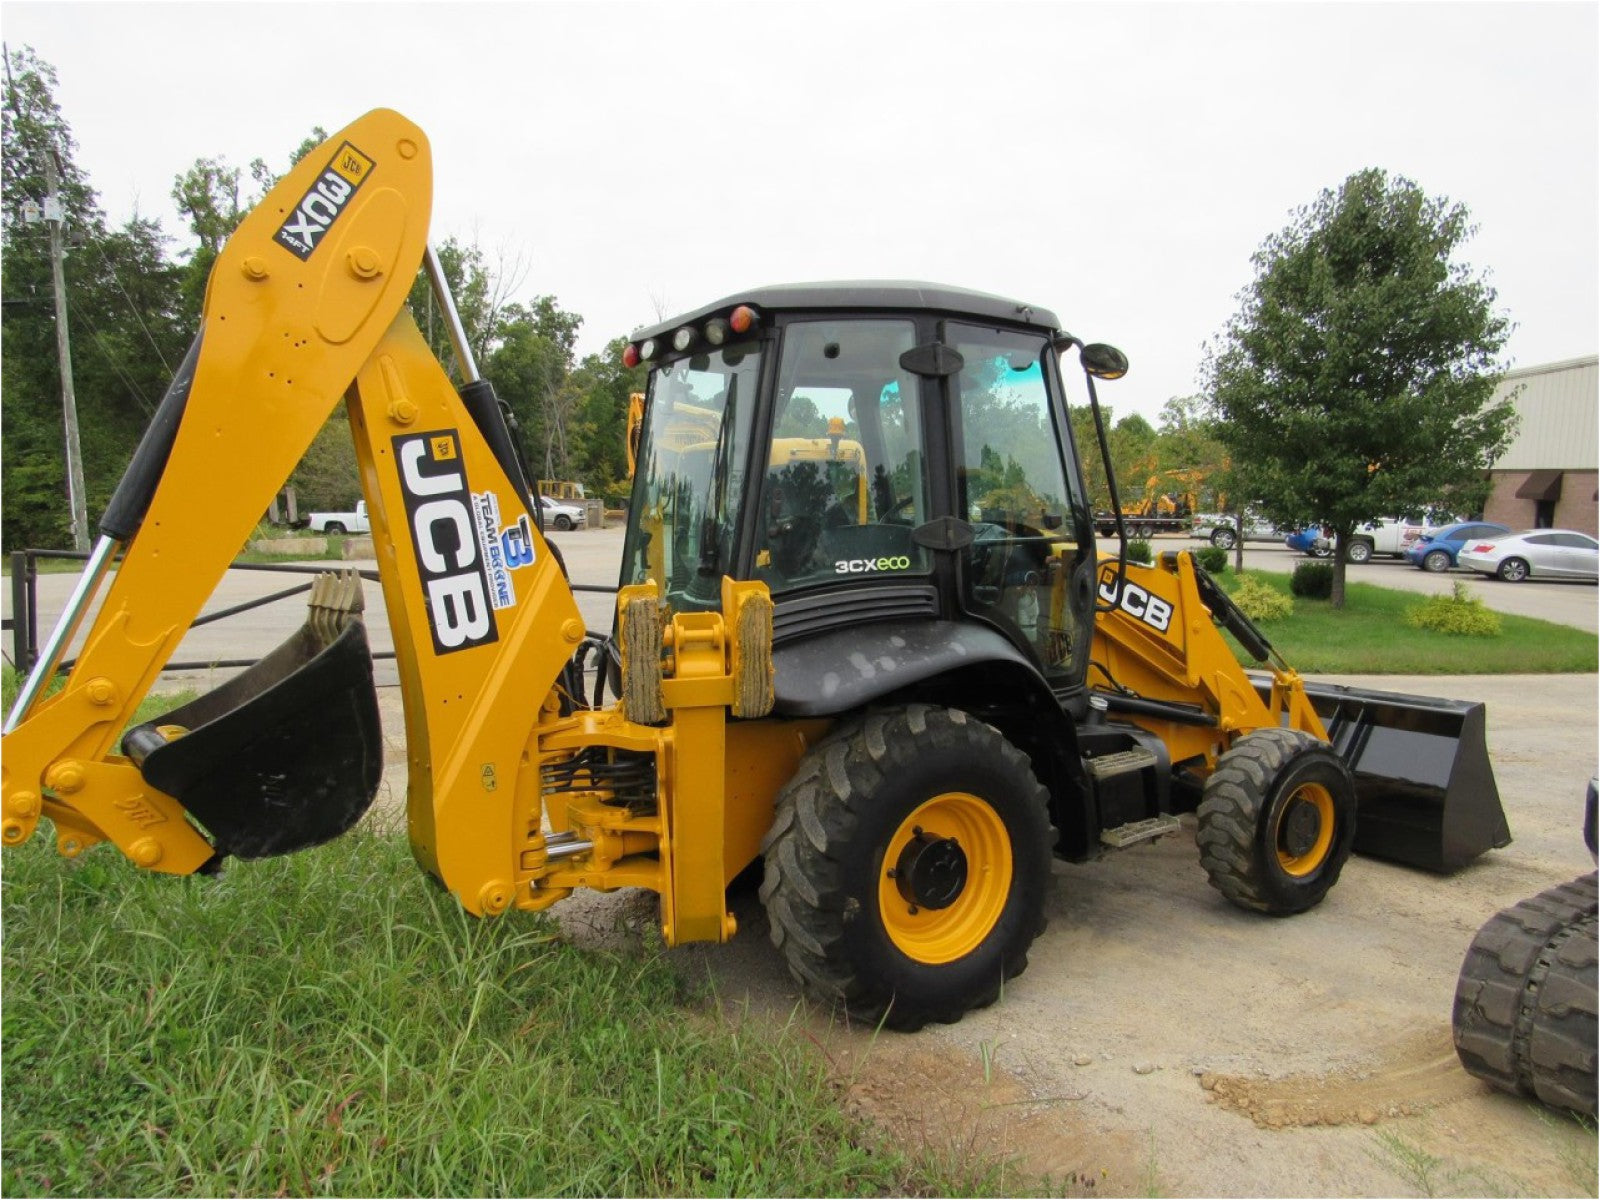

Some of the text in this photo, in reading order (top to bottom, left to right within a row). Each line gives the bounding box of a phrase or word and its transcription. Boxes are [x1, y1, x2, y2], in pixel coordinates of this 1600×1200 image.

[342, 155, 363, 175] JCB
[283, 172, 352, 248] 3CX
[281, 231, 311, 253] 14FT
[401, 438, 490, 648] JCB
[480, 493, 498, 544] TEAM
[1099, 580, 1172, 631] JCB
